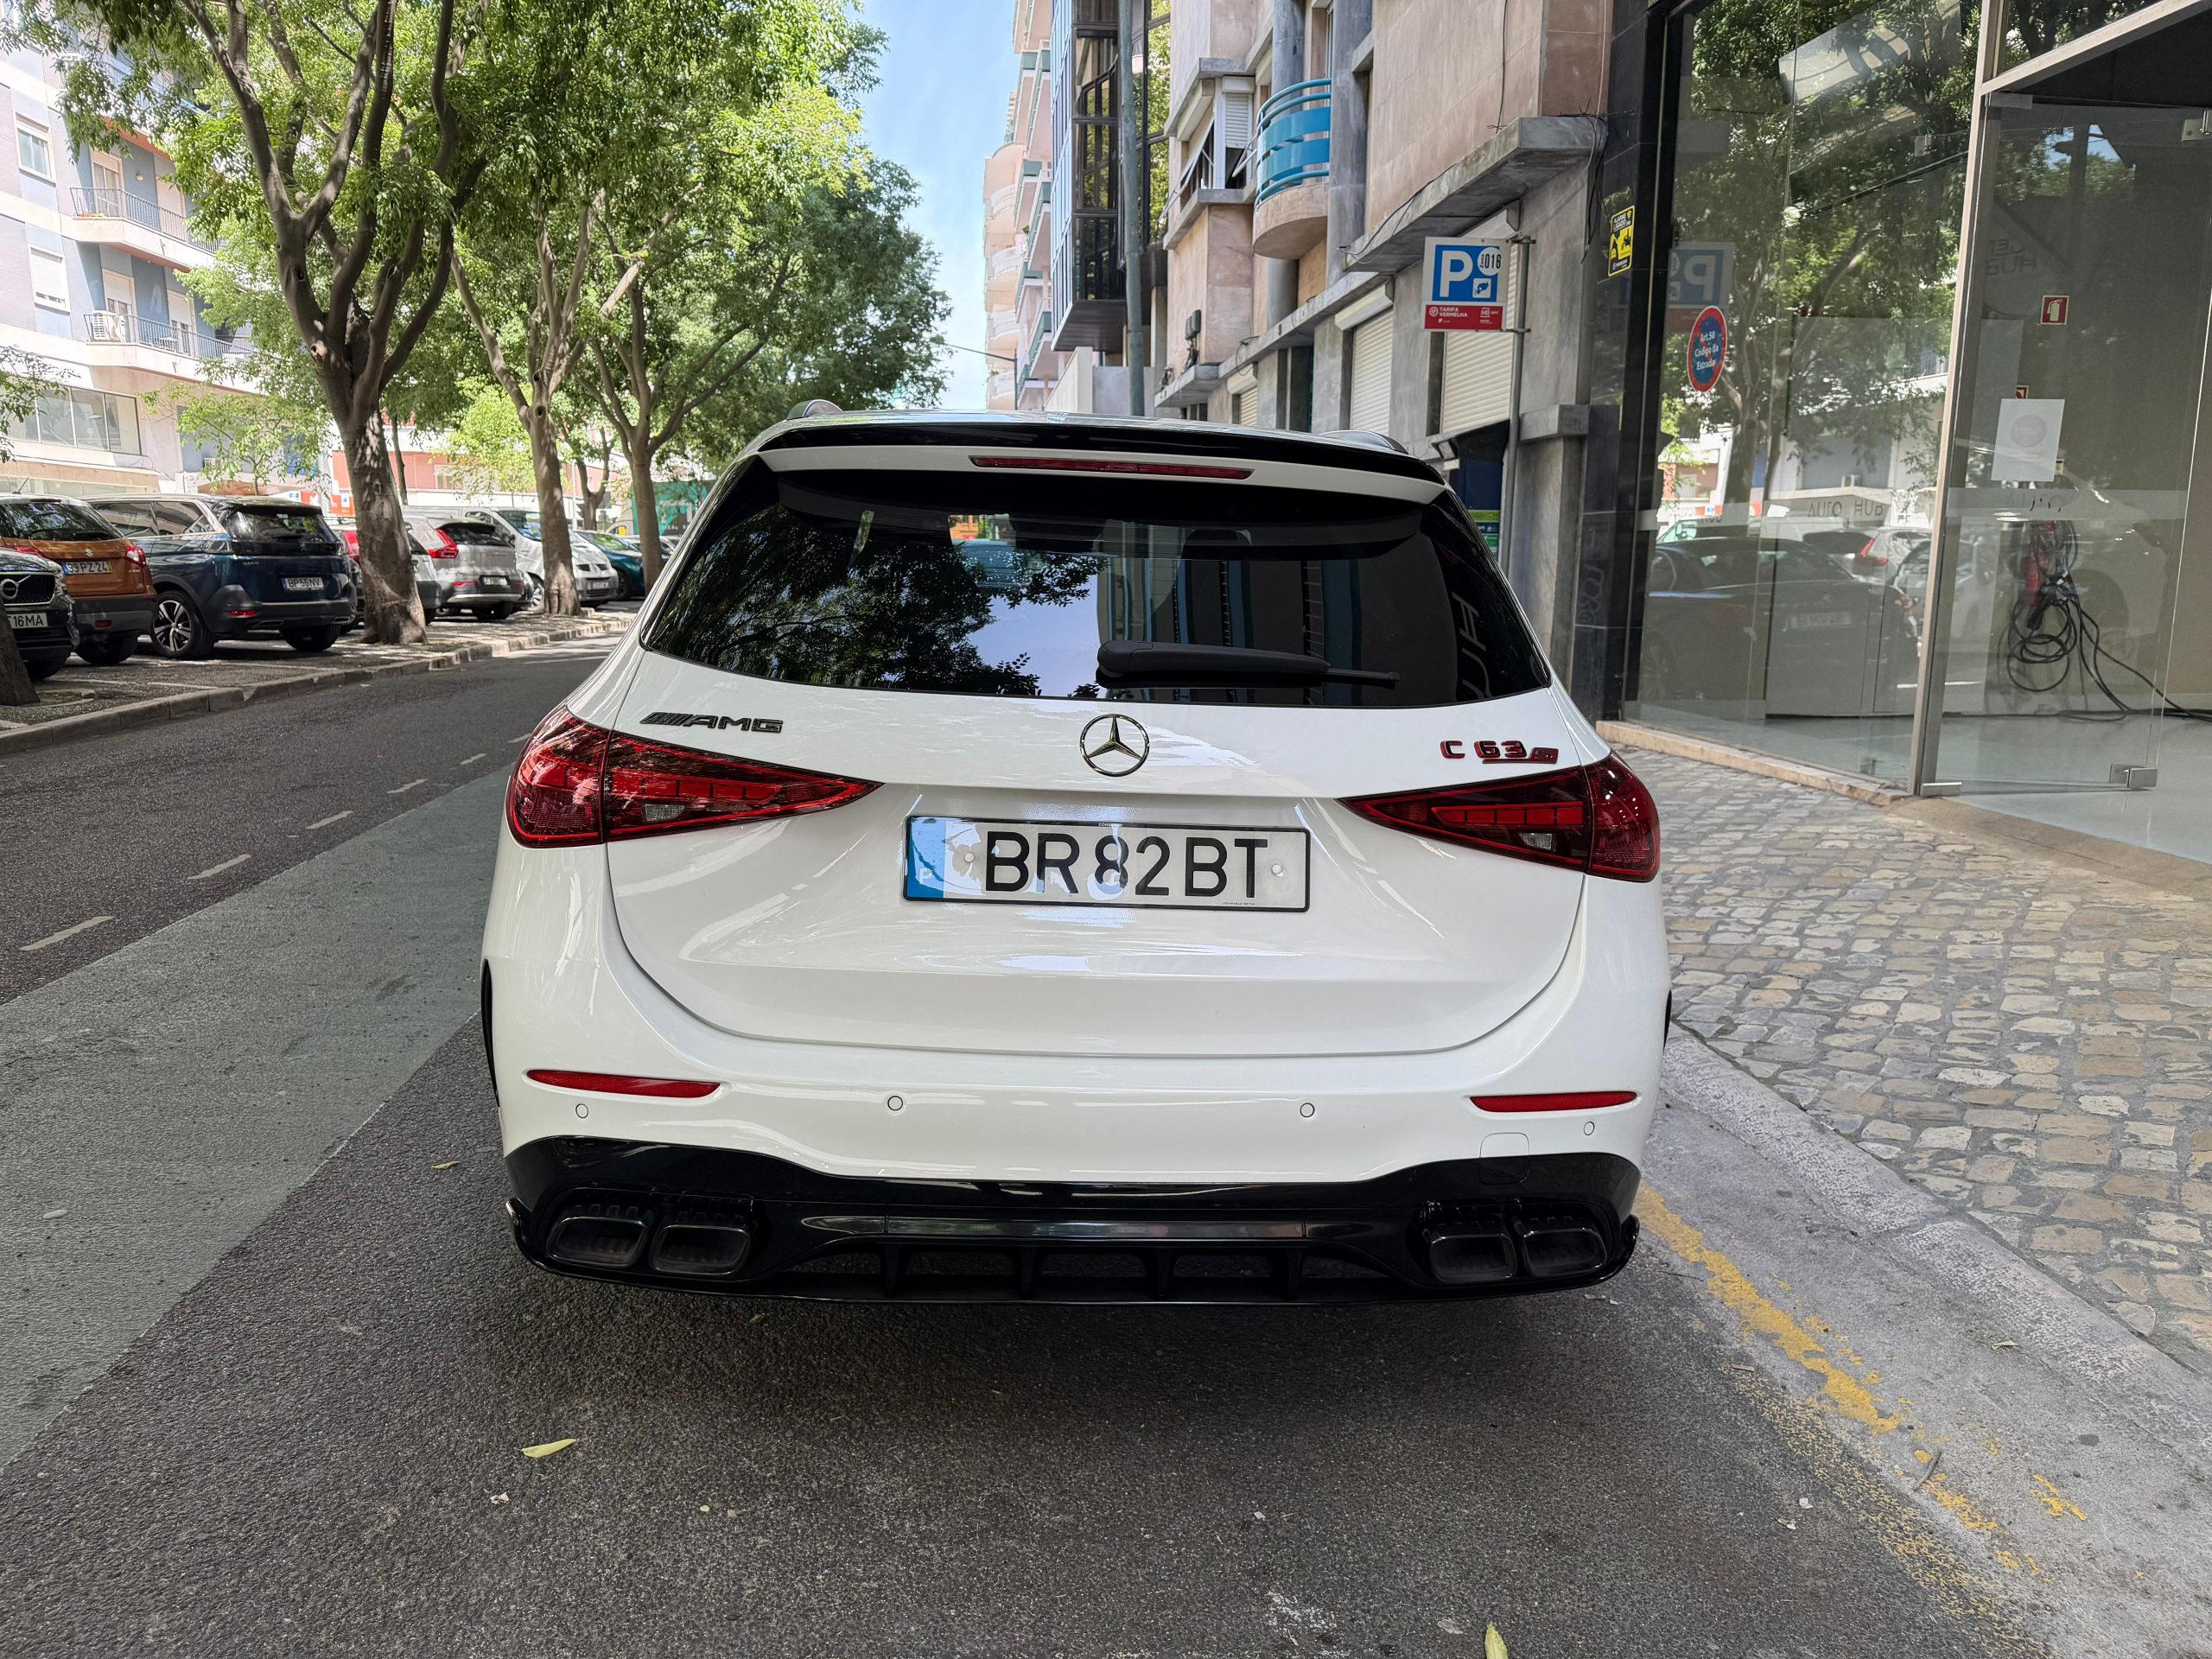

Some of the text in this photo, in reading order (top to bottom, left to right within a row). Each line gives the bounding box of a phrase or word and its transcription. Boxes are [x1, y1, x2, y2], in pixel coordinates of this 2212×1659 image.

[1484, 253, 1502, 269] 016
[1440, 251, 1474, 297] P
[681, 714, 784, 734] AMG
[1440, 741, 1465, 759] C
[1473, 741, 1528, 759] 63
